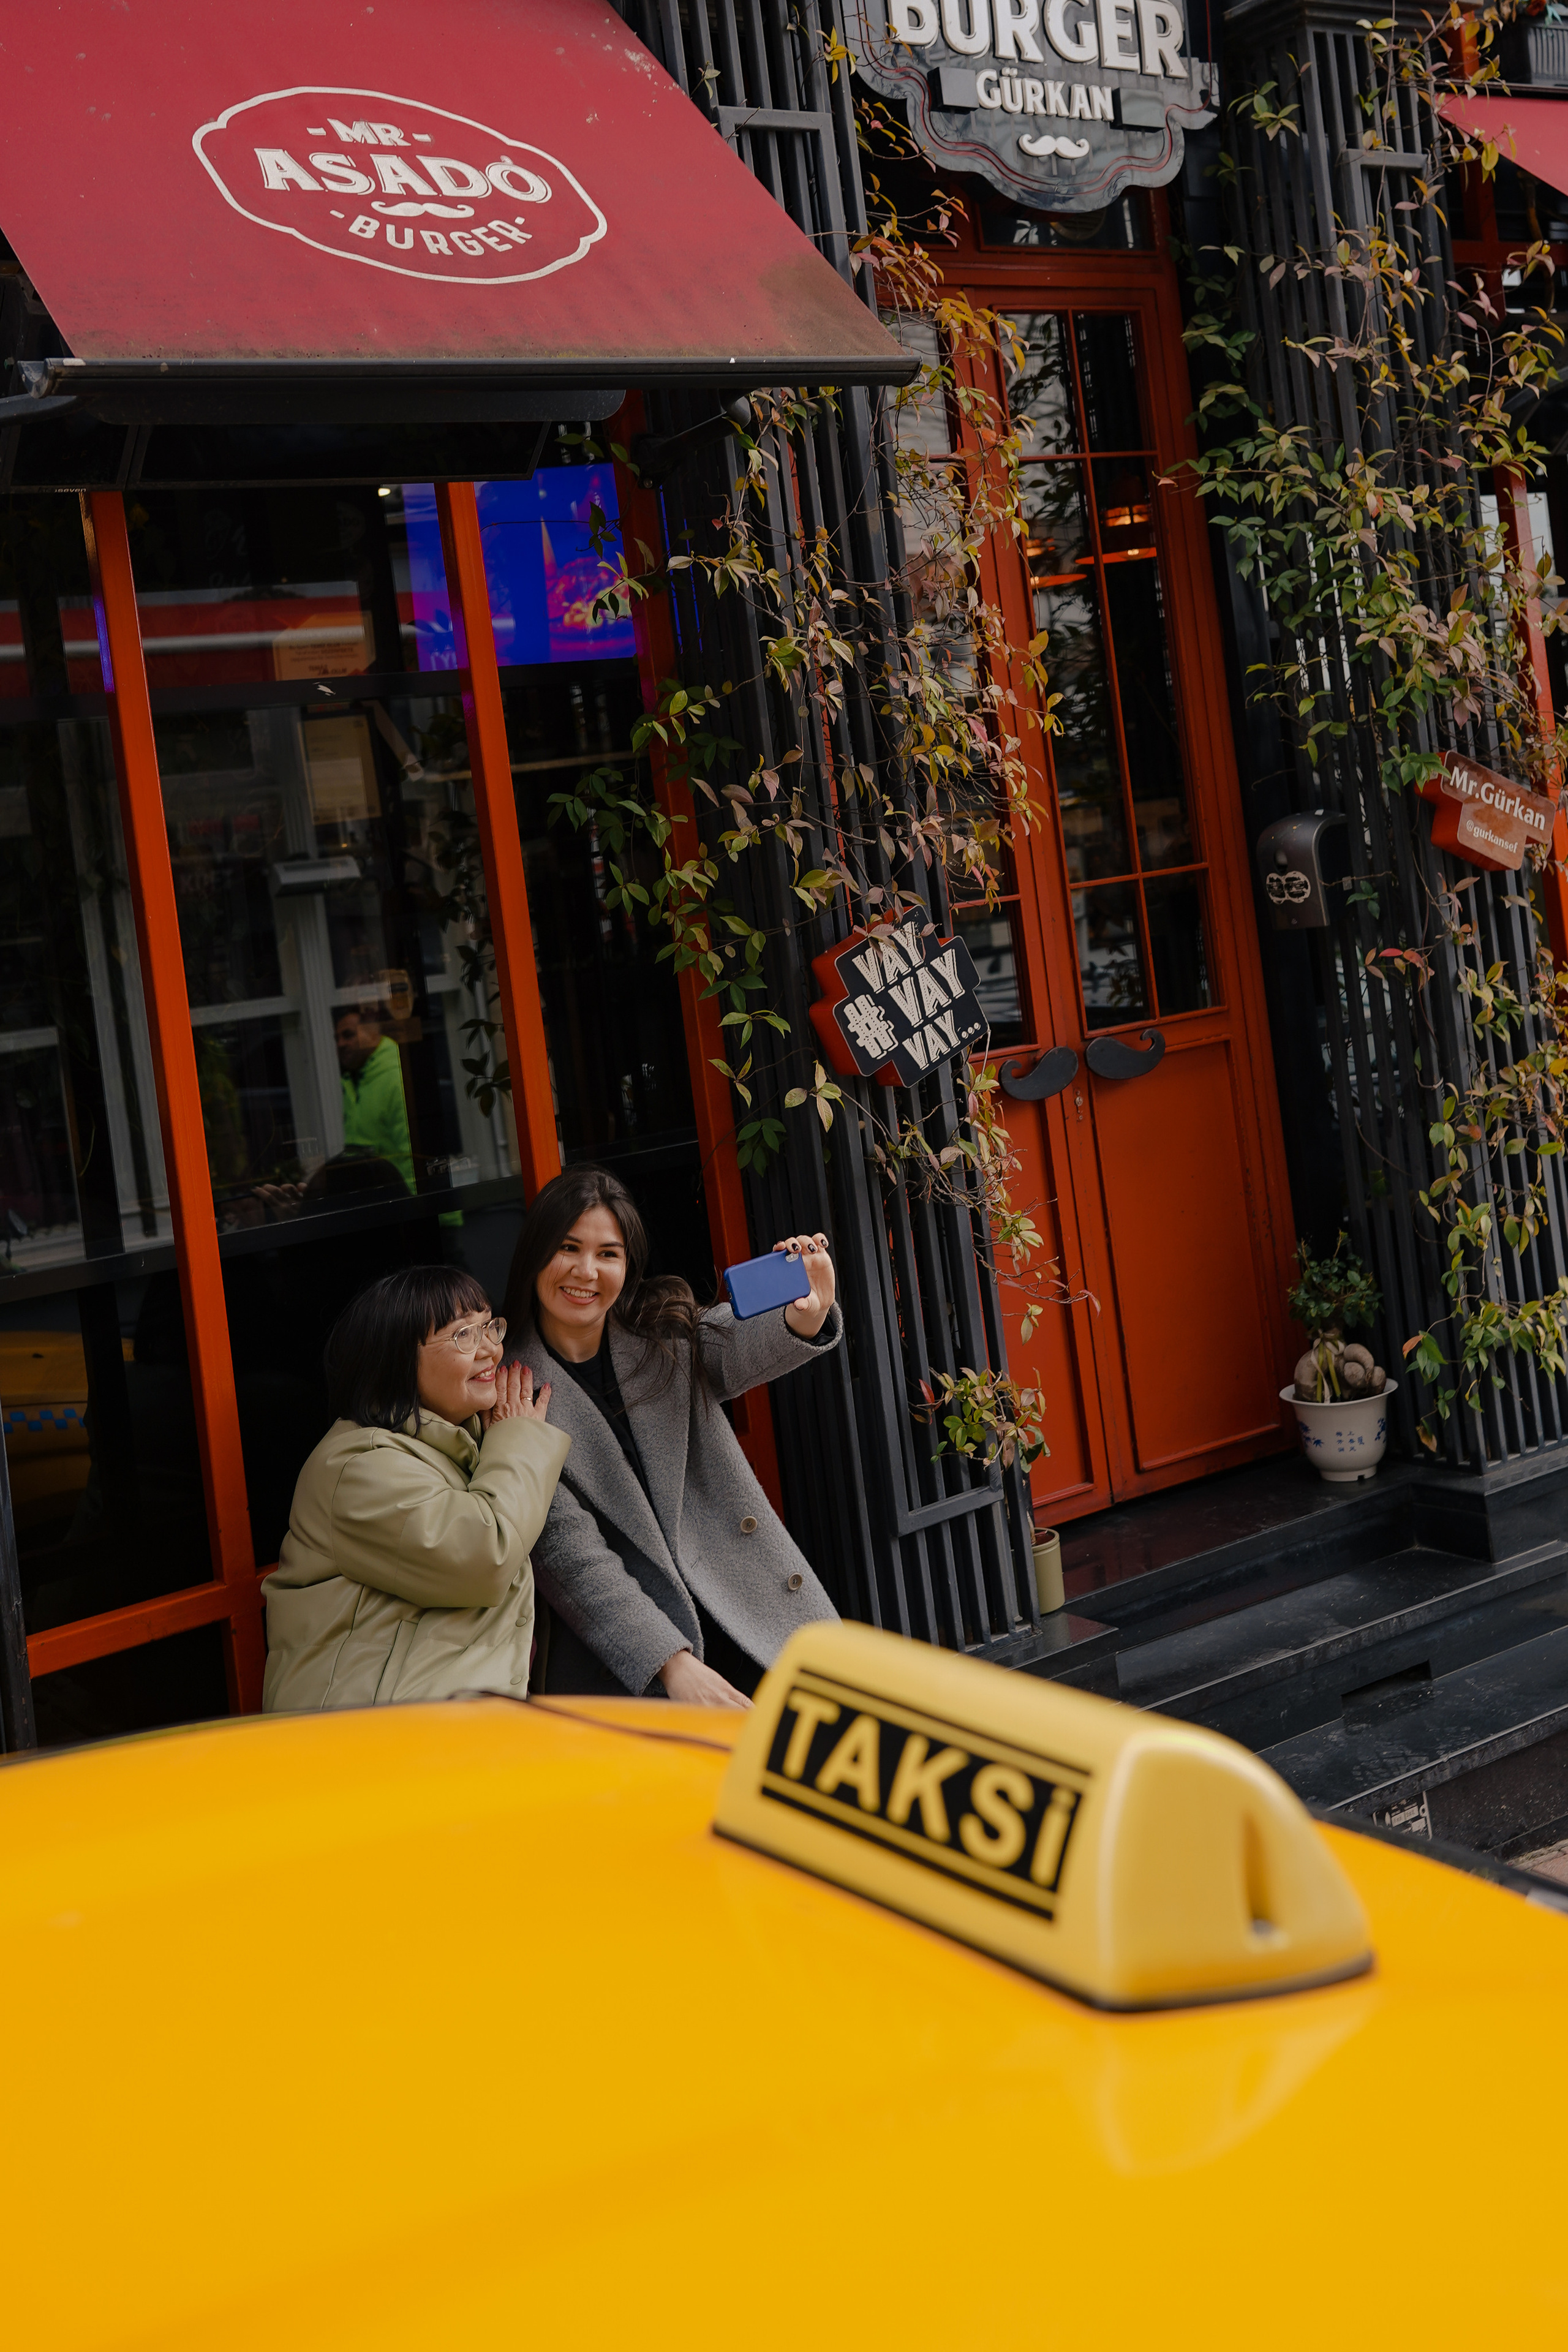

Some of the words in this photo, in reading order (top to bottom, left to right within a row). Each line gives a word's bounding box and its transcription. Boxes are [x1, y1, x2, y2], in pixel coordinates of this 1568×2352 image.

[888, 0, 1188, 78] BURGER
[975, 67, 1114, 122] GÜRKAN
[348, 214, 532, 256] BURGER
[1449, 766, 1546, 831] Mr.Gürkan
[1466, 820, 1518, 854] @gurkansef
[852, 921, 924, 994] VAY
[843, 994, 899, 1060] #
[888, 949, 965, 1028] VAY
